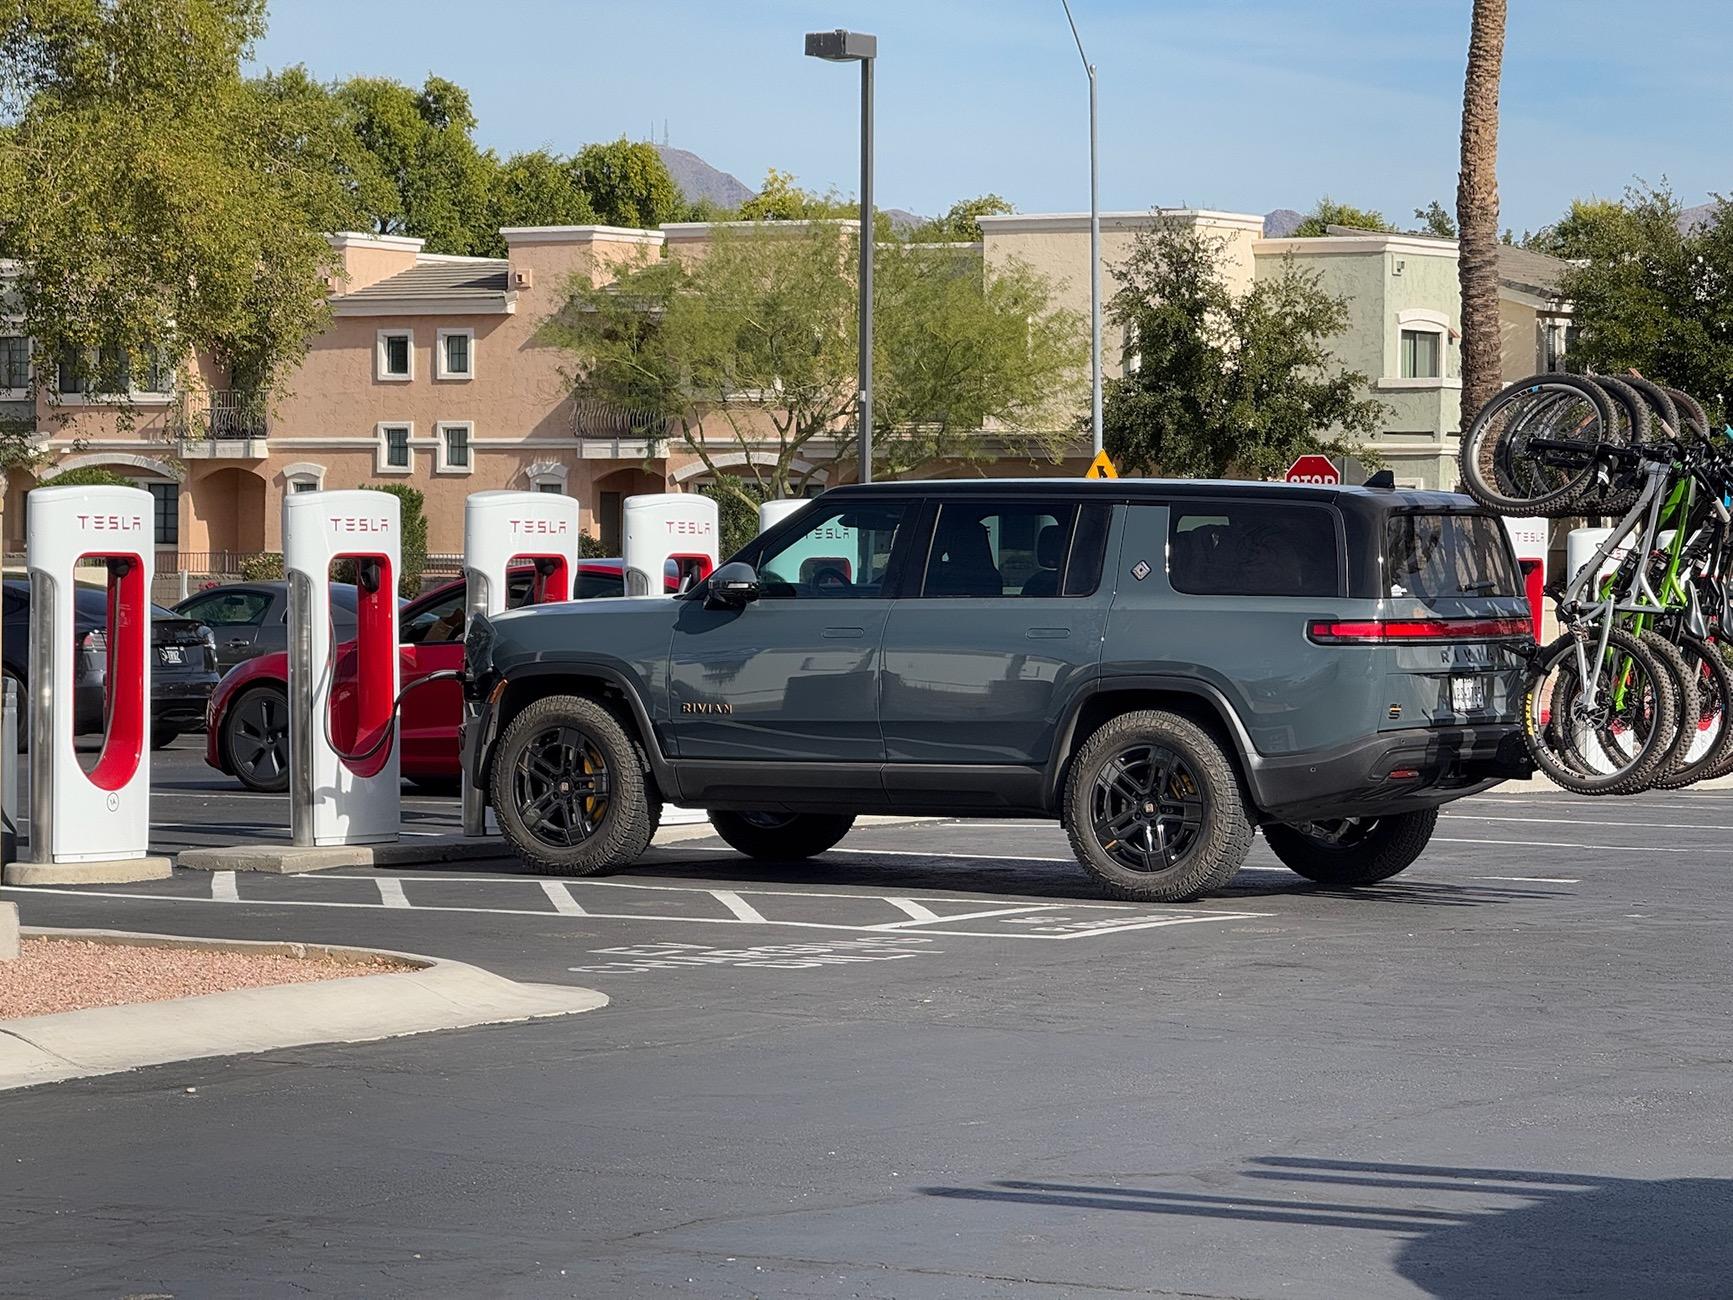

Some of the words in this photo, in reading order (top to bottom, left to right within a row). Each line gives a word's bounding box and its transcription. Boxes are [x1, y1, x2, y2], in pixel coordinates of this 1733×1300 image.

[77, 515, 141, 530] TESLA
[330, 518, 389, 532] TESLA
[510, 520, 567, 534] TESLA
[665, 521, 711, 535] TESLA
[1515, 531, 1545, 543] TESLA
[682, 702, 733, 714] RIVIAN
[567, 936, 935, 974] CHARGING
[586, 942, 717, 956] EV
[732, 947, 945, 969] ONLY
